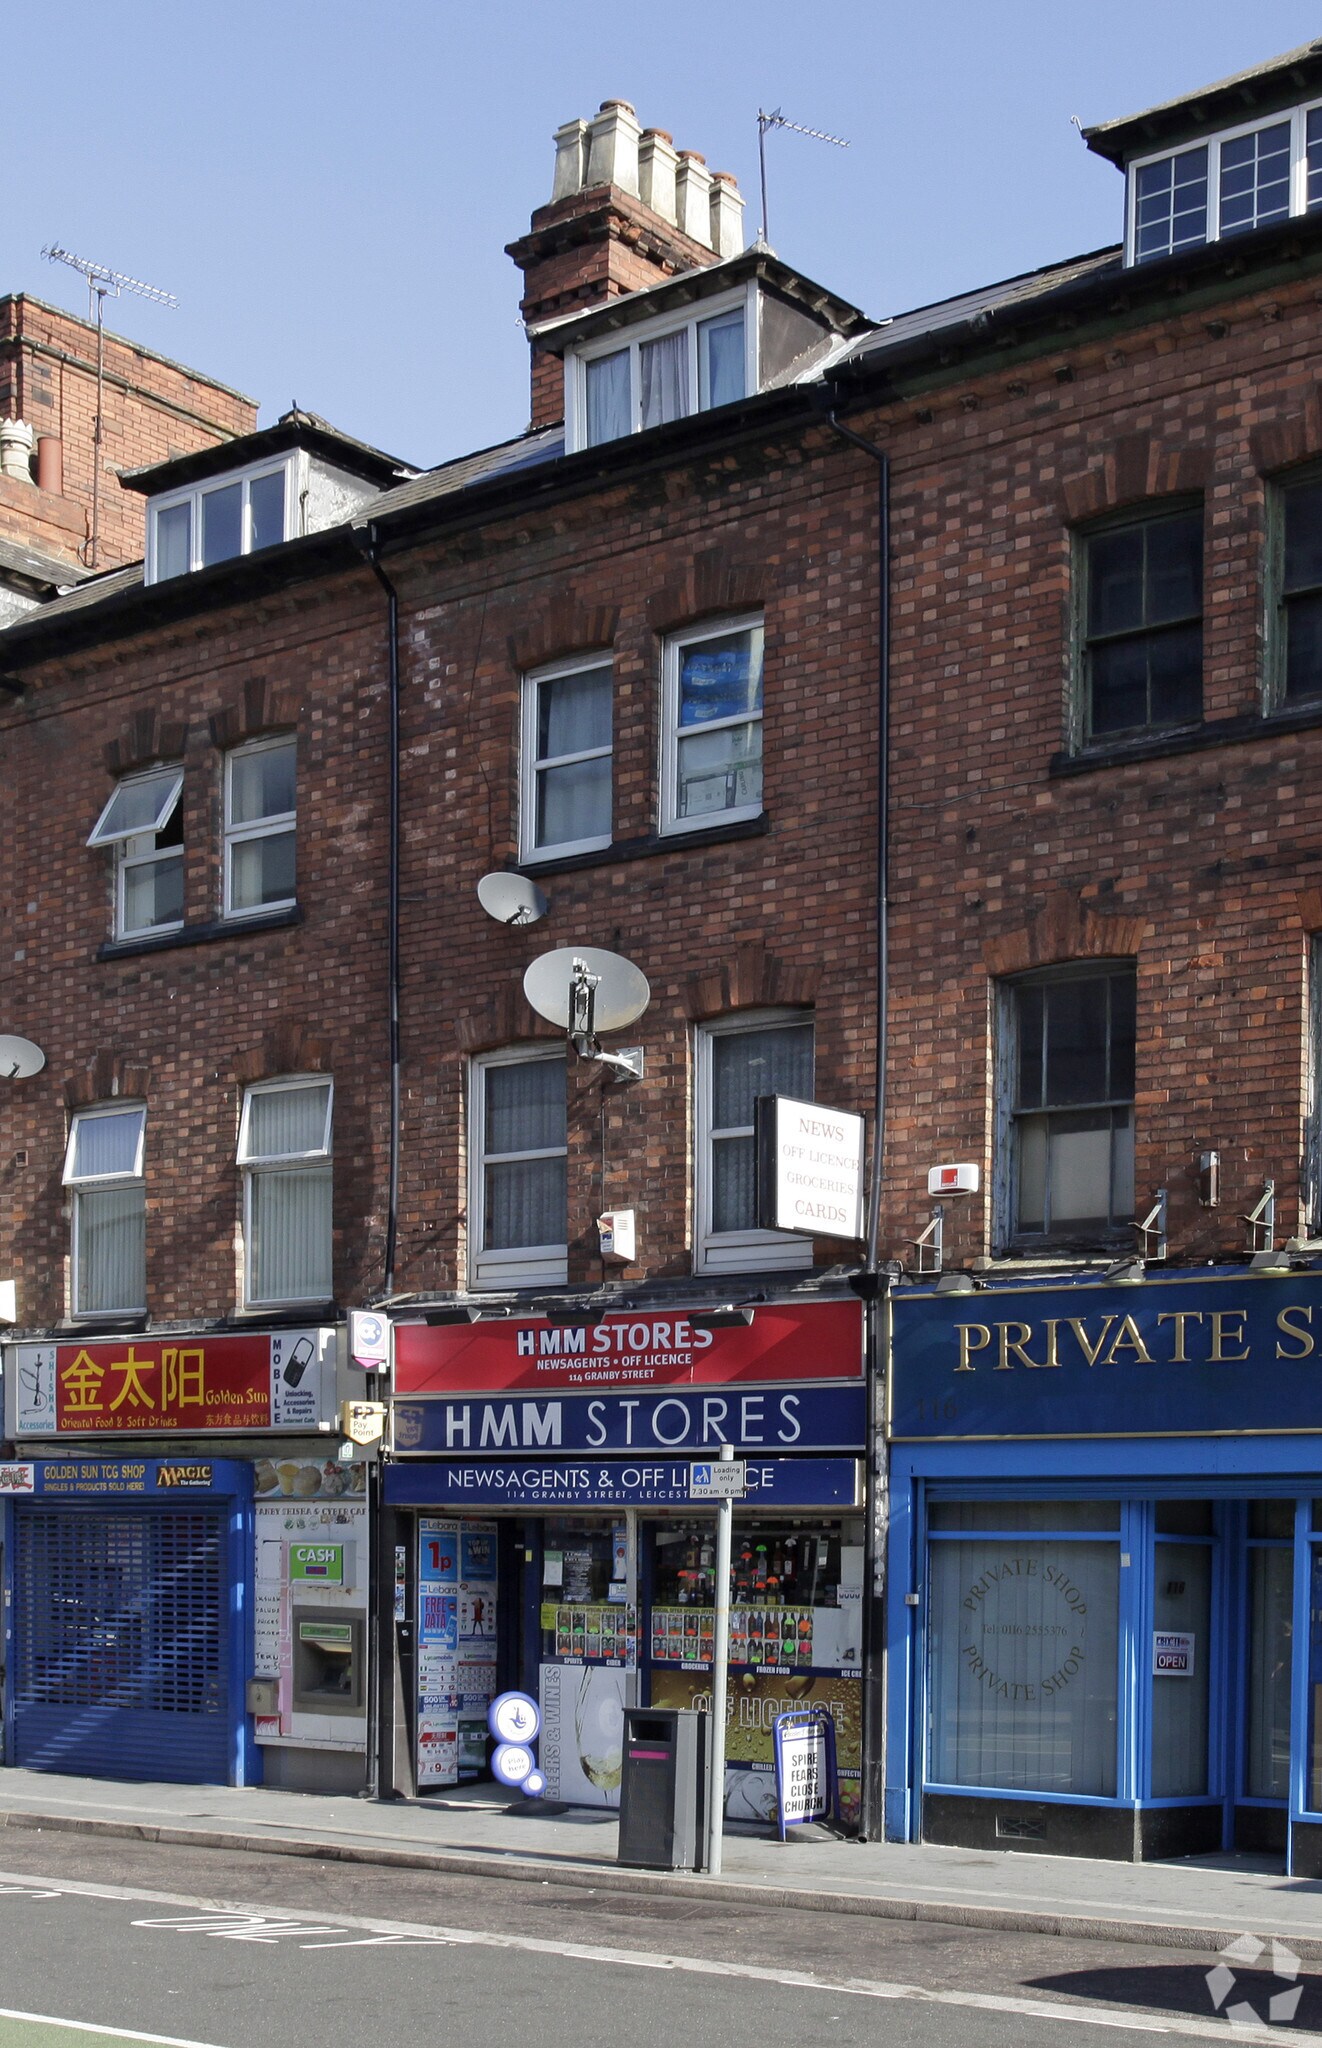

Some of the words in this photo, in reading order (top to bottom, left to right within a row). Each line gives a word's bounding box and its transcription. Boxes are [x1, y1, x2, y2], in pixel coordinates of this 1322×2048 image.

[799, 1118, 844, 1142] NEWS
[782, 1144, 805, 1158] OFF
[786, 1171, 854, 1195] GROCERIES
[795, 1199, 847, 1223] CARDS
[517, 1327, 586, 1356] HMM
[592, 1321, 714, 1353] STORES
[953, 1310, 1251, 1372] PRIVATE
[1276, 1305, 1322, 1359] S
[536, 1356, 610, 1371] NEWSAGENTS
[621, 1355, 642, 1367] OFF
[644, 1353, 692, 1366] LICENCE
[60, 1347, 205, 1412] 金太阳
[272, 1339, 282, 1424] MOBILE
[568, 1373, 583, 1382] 114
[584, 1371, 620, 1381] GRANBY
[622, 1369, 655, 1379] STREET
[205, 1388, 244, 1405] Golden
[246, 1387, 268, 1404] Sun
[292, 1407, 312, 1415] Repairs
[19, 1419, 55, 1430] Accessories
[61, 1416, 93, 1429] Oriental
[95, 1416, 113, 1427] Food
[126, 1415, 146, 1427] Soft
[149, 1415, 178, 1427] Drinks
[354, 1421, 368, 1429] Pay
[446, 1402, 562, 1448] HMM
[585, 1394, 801, 1446] STORES
[353, 1429, 374, 1437] Point
[44, 1466, 77, 1479] GOLDEN
[81, 1465, 99, 1479] SUN
[101, 1465, 119, 1479] TCG
[122, 1464, 146, 1478] SHOP
[156, 1466, 212, 1487] MAGIC
[713, 1466, 740, 1475] Loading
[448, 1469, 590, 1489] NEWSAGENTS
[598, 1470, 614, 1488] &
[621, 1468, 664, 1488] OFF
[672, 1468, 775, 1488] LICE
[44, 1483, 69, 1492] SINGLES
[76, 1482, 107, 1491] PRODUCTS
[587, 1490, 632, 1498] STREET,
[731, 1488, 741, 1496] pm
[428, 1521, 457, 1530] Lebara
[467, 1523, 496, 1532] Lebara
[296, 1549, 336, 1562] CASH
[428, 1541, 452, 1572] 1p
[428, 1585, 457, 1594] Lebara
[963, 1558, 1038, 1612] PRIVATE
[1042, 1565, 1087, 1616] SHOP
[425, 1597, 447, 1612] FREE
[766, 1605, 780, 1613] OFFER
[425, 1613, 446, 1629] DATA
[1001, 1625, 1023, 1635] 0116
[1026, 1624, 1067, 1635] 2555376
[564, 1657, 583, 1665] SPIRITS
[681, 1661, 709, 1671] GROCERIES
[1158, 1655, 1185, 1668] OPEN
[756, 1665, 776, 1674] FROZEN
[776, 1667, 791, 1675] FOOD
[962, 1644, 1036, 1701] PRIVATE
[1041, 1646, 1085, 1697] SHOP
[545, 1666, 560, 1725] WINES
[546, 1728, 560, 1741] &
[791, 1752, 818, 1767] SPIRE
[508, 1764, 526, 1772] here
[544, 1744, 560, 1800] BEERS
[752, 1763, 772, 1771] CHILLED
[791, 1768, 818, 1782] FEARS
[791, 1784, 818, 1798] CLOSE
[784, 1796, 823, 1814] CHURCH
